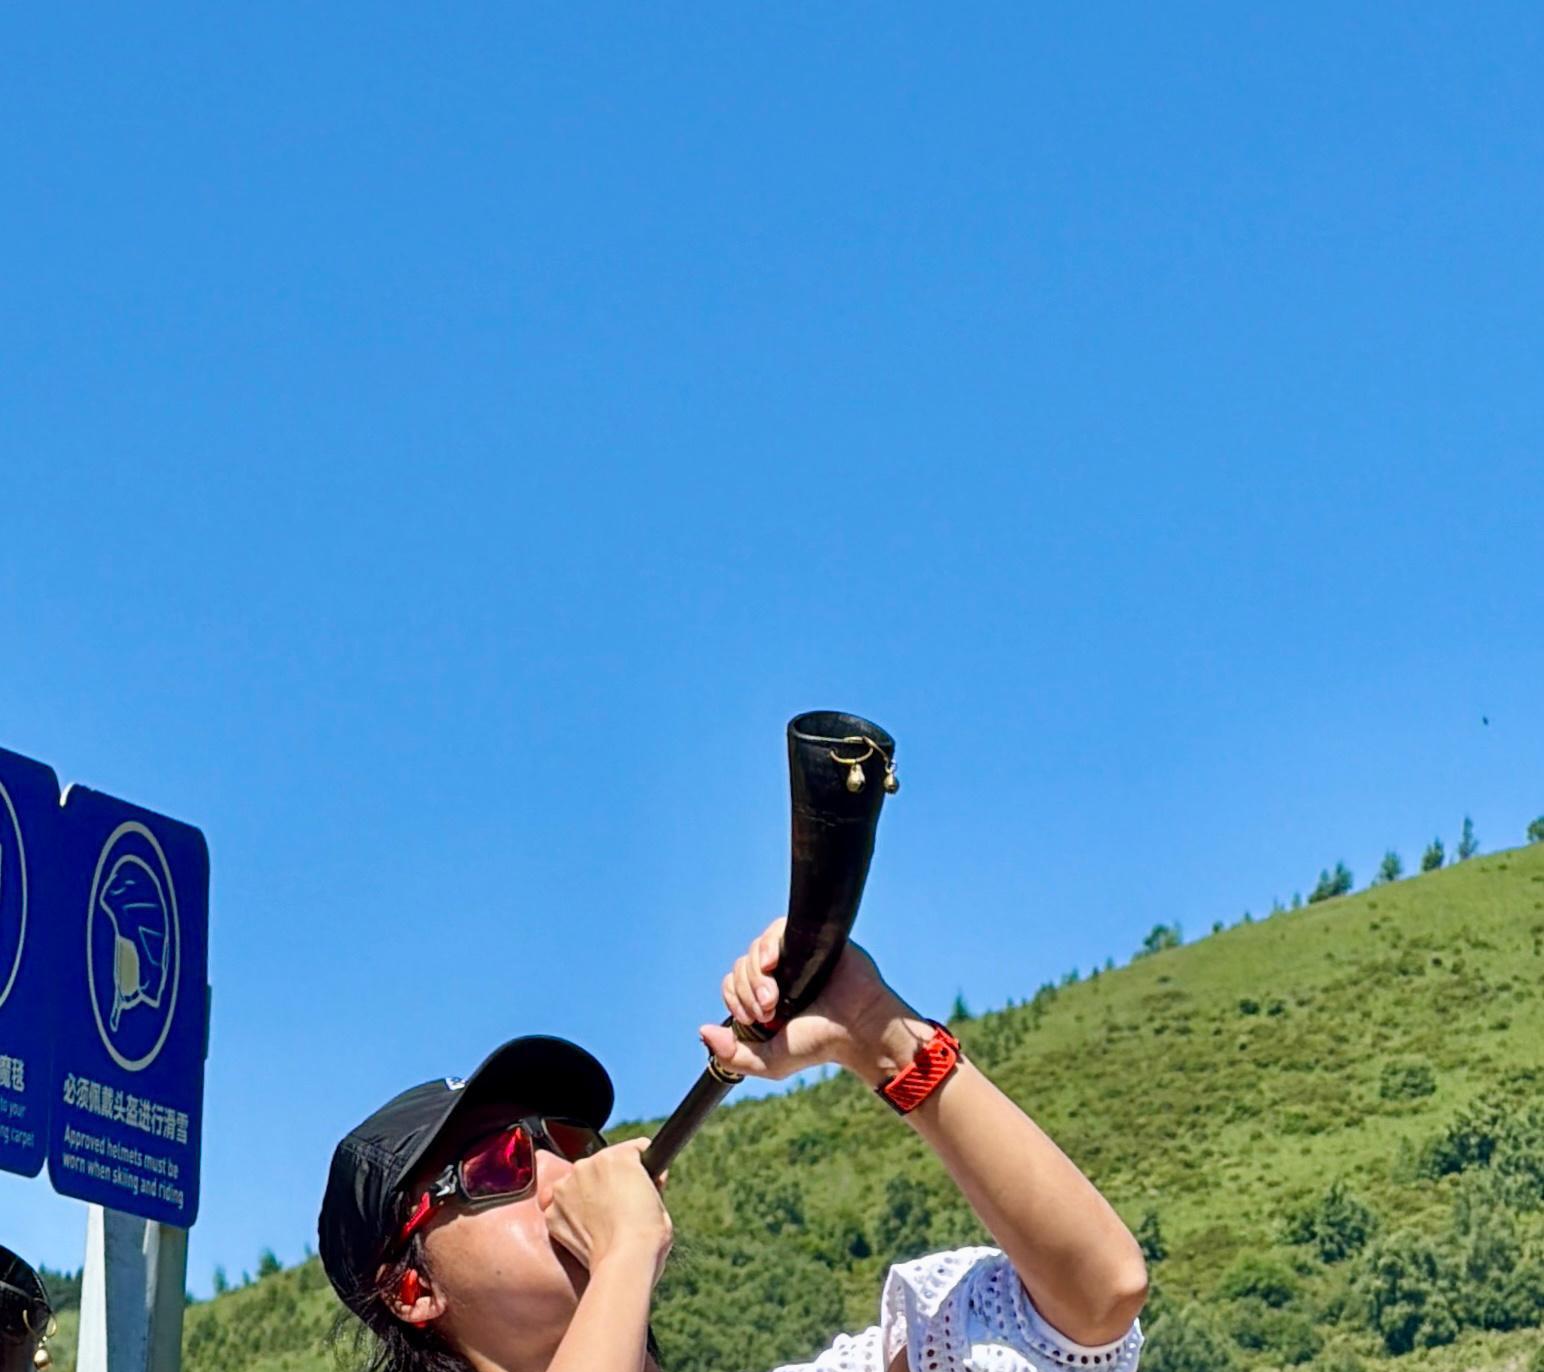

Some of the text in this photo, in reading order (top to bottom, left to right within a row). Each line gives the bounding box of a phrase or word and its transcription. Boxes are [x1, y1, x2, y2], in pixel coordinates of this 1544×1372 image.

[63, 1072, 188, 1144] 必须佩戴头盔进行滑雪
[64, 1122, 179, 1180] Approved helmets must be
[63, 1152, 184, 1210] worn when skiing and riding
